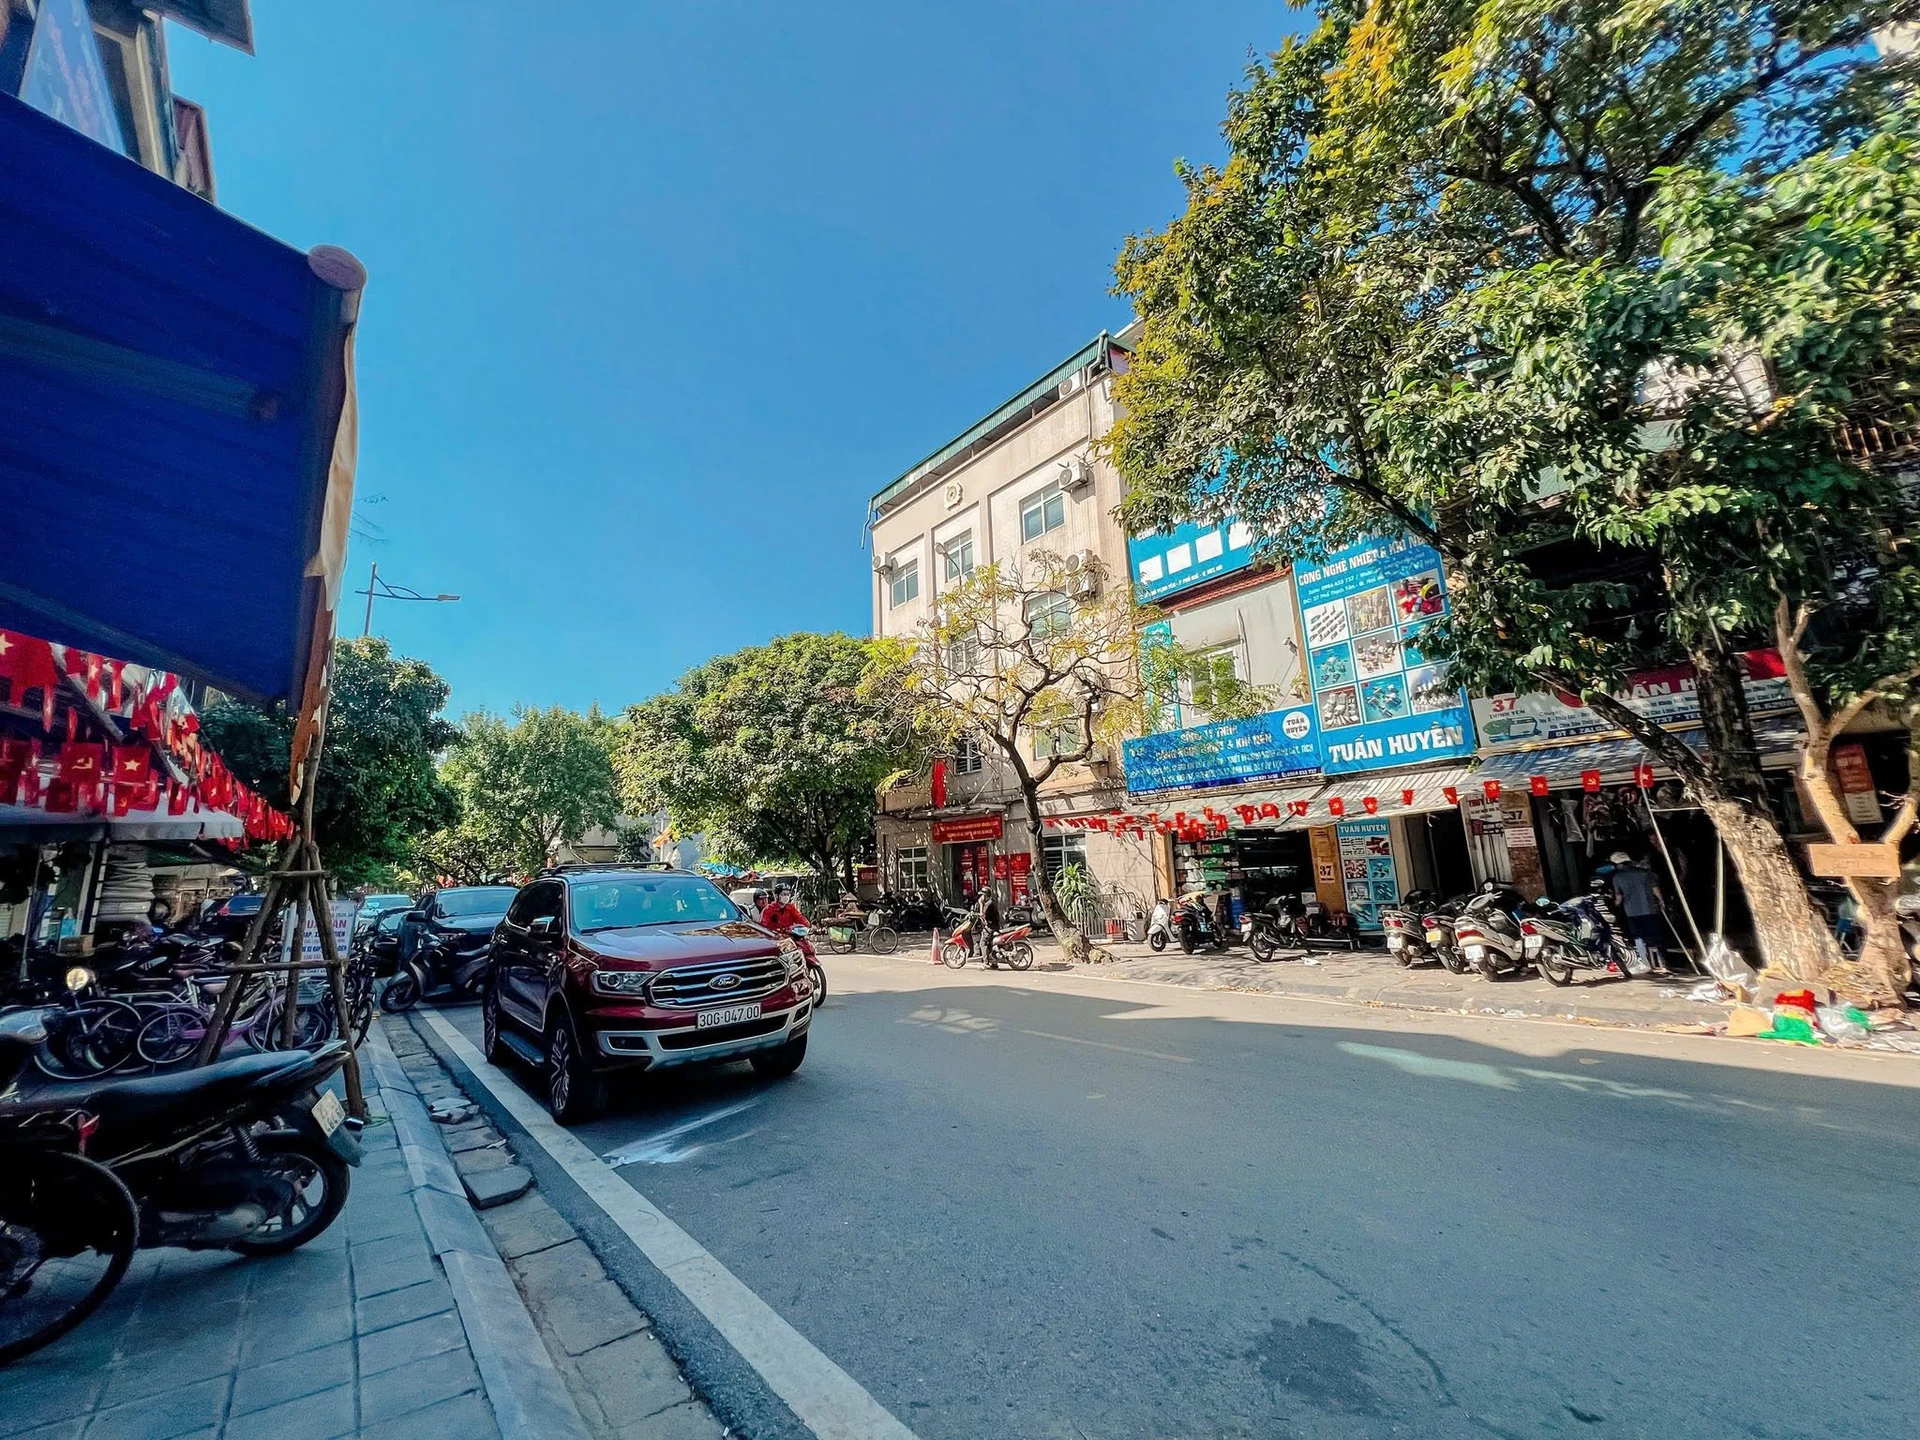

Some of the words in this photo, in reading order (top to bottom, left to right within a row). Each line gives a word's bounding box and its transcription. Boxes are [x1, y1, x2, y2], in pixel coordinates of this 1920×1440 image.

[1298, 569, 1321, 587] CÔNG
[1322, 556, 1348, 579] NGHỆ
[1490, 697, 1516, 713] 37
[1328, 734, 1383, 763] TUẤN
[1387, 721, 1464, 756] HUYỀN
[1319, 865, 1332, 876] 37
[717, 977, 735, 987] Ford
[699, 1005, 760, 1028] 30G-047.00
